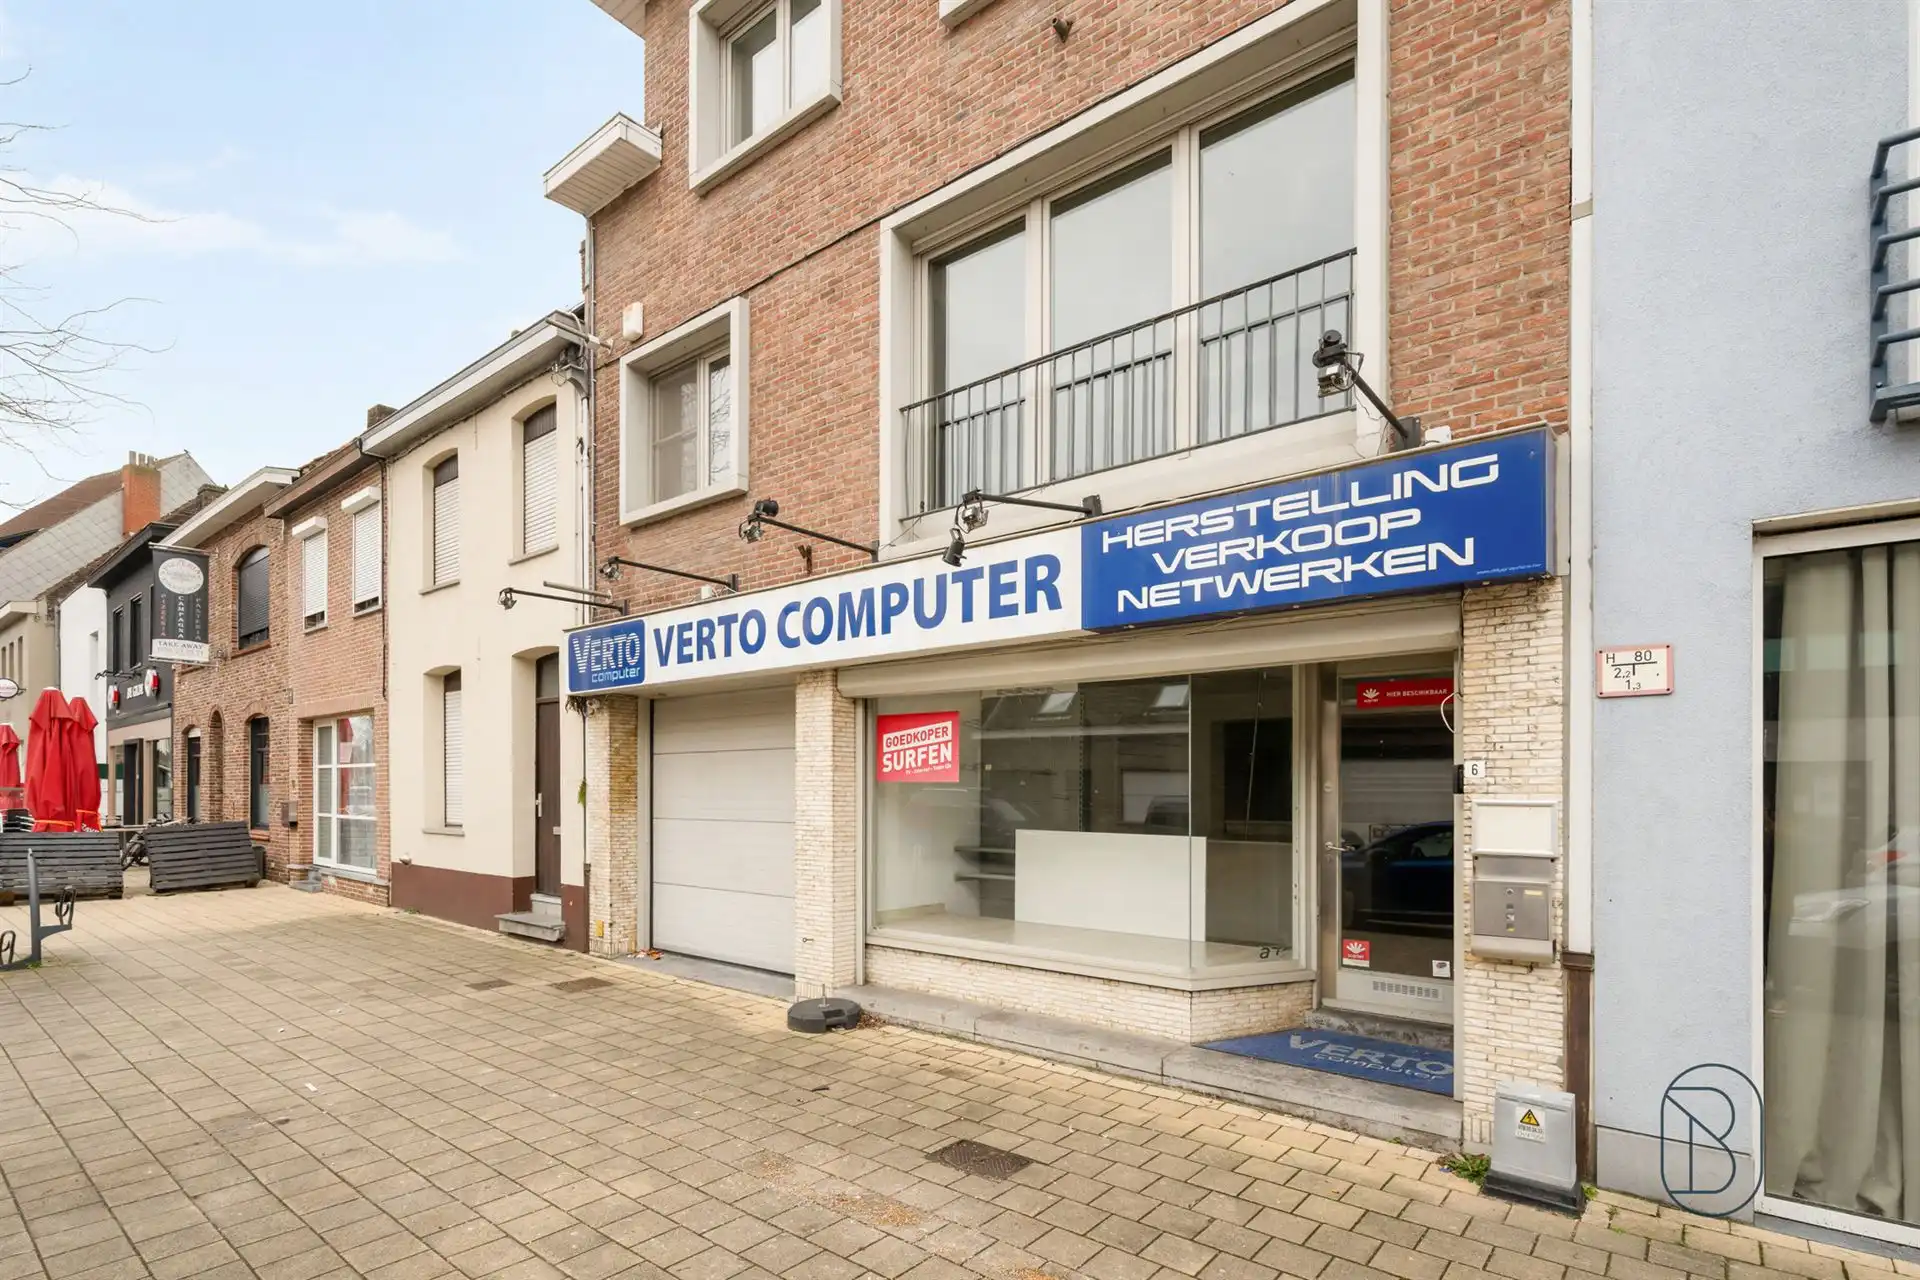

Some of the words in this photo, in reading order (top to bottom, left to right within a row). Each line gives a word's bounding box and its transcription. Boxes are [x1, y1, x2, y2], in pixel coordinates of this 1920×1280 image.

[1102, 453, 1500, 554] HERSTELLING
[1152, 508, 1422, 575] VERKOOP
[1117, 536, 1475, 613] NETWERKEN
[653, 608, 767, 668] VERTO
[777, 553, 1063, 649] COMPUTER
[157, 640, 178, 648] TAKE
[181, 642, 204, 651] AWAY
[573, 633, 641, 674] VERTO
[1605, 653, 1616, 665] H
[1634, 650, 1652, 662] 80
[591, 666, 642, 685] computer
[1386, 690, 1401, 698] HIER
[1402, 689, 1448, 697] BESCHIKBAAR
[886, 726, 949, 749] GOEDKOPER
[882, 741, 953, 773] SURFEN
[1471, 763, 1479, 777] 6
[1290, 1033, 1454, 1076] VERTO
[1313, 1053, 1448, 1081] computer
